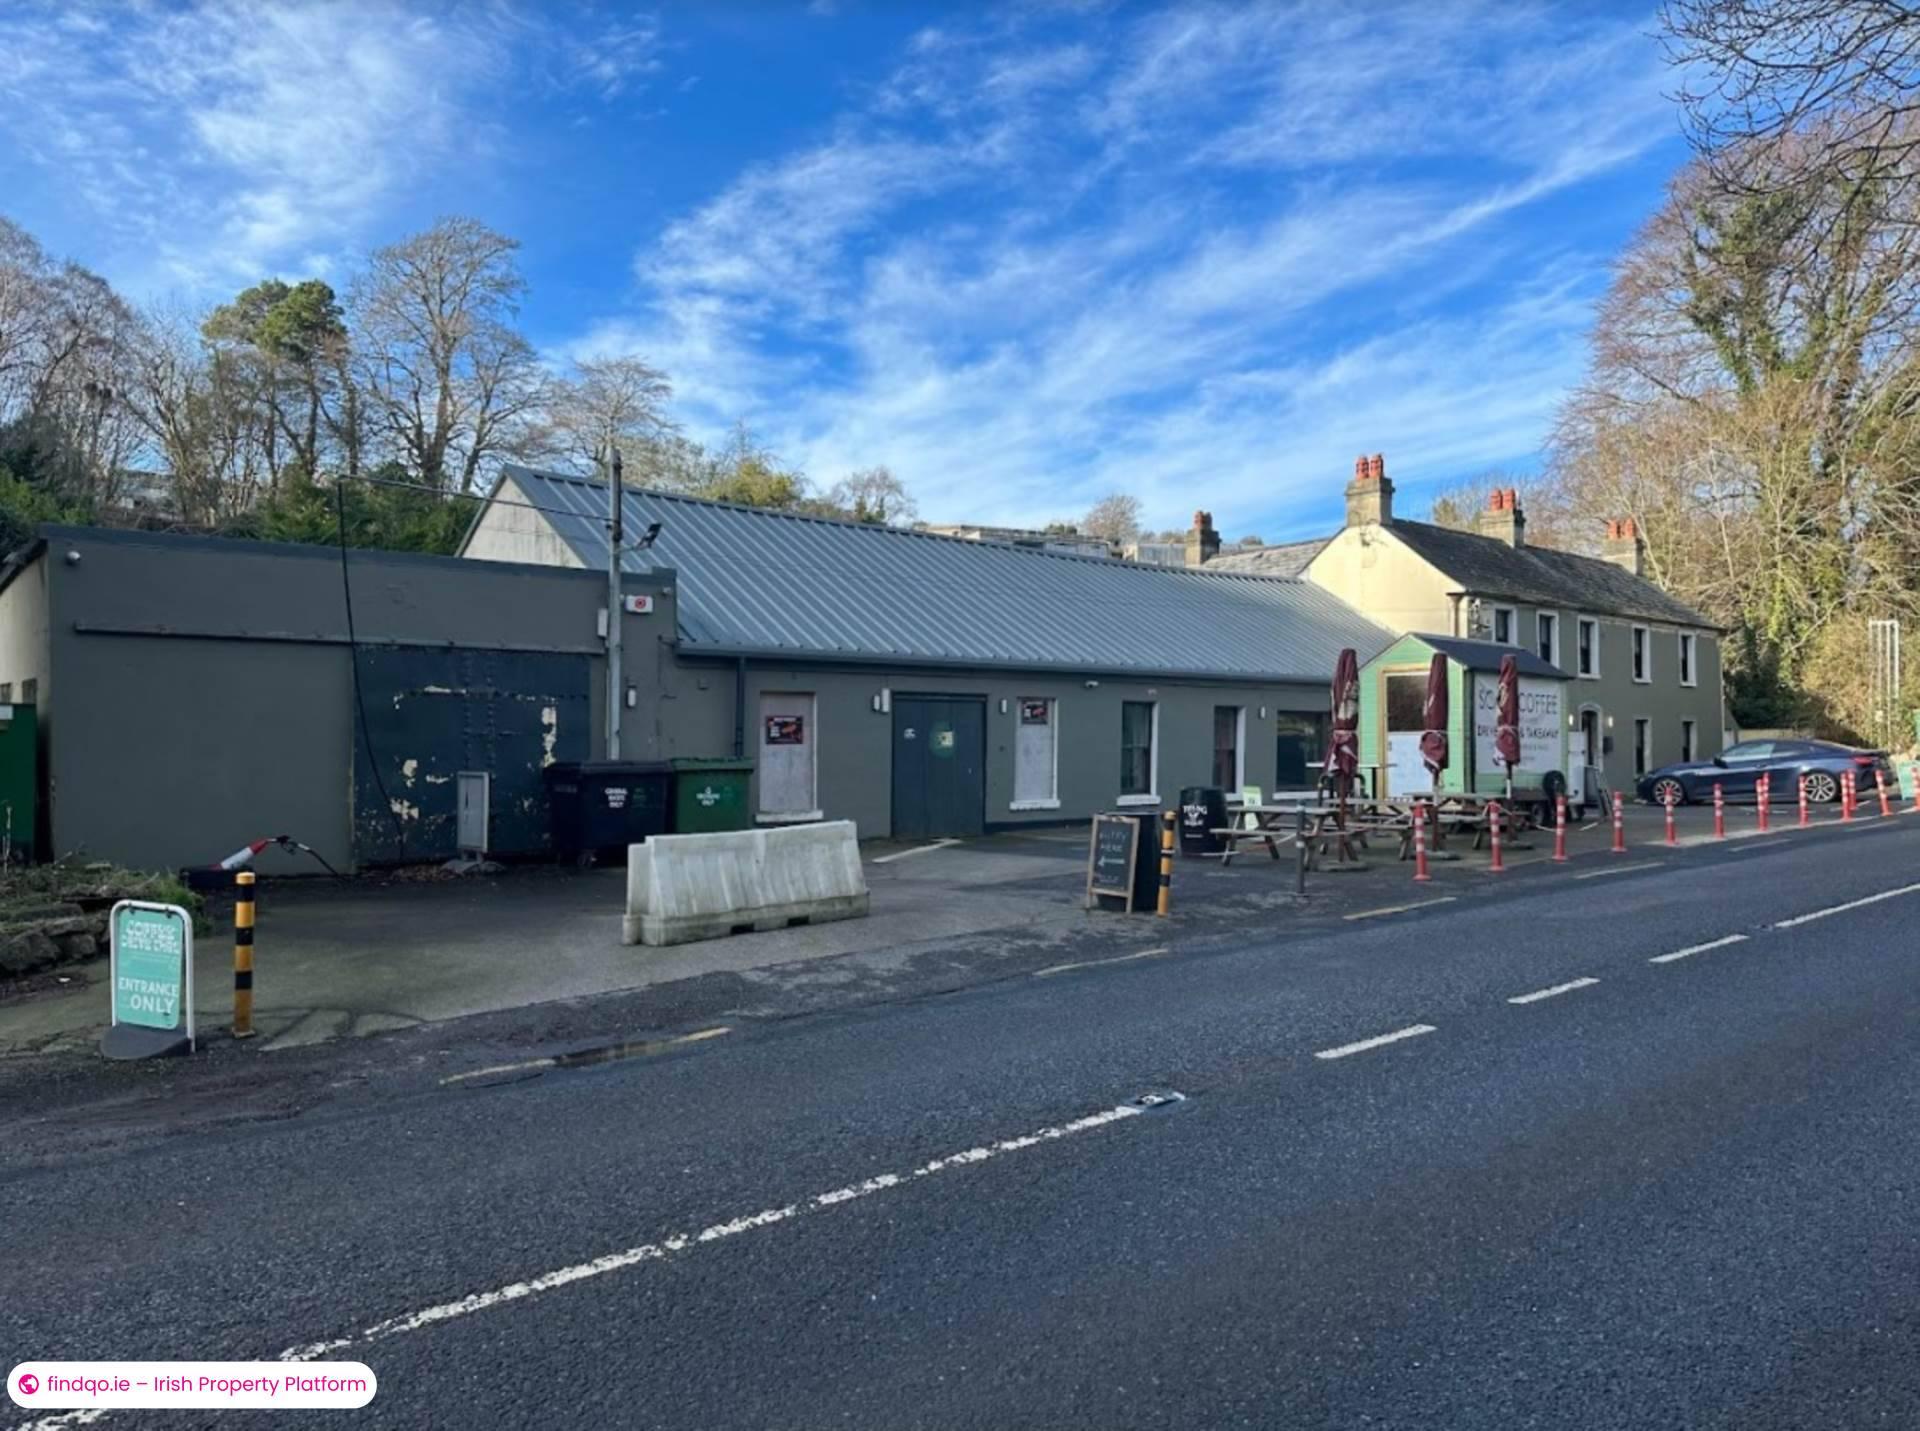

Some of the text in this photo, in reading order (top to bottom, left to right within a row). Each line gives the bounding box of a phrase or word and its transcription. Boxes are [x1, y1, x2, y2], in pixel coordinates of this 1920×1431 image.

[1519, 692, 1558, 715] COFFEE
[118, 977, 178, 998] ENTRANCE
[130, 996, 175, 1014] ONLY
